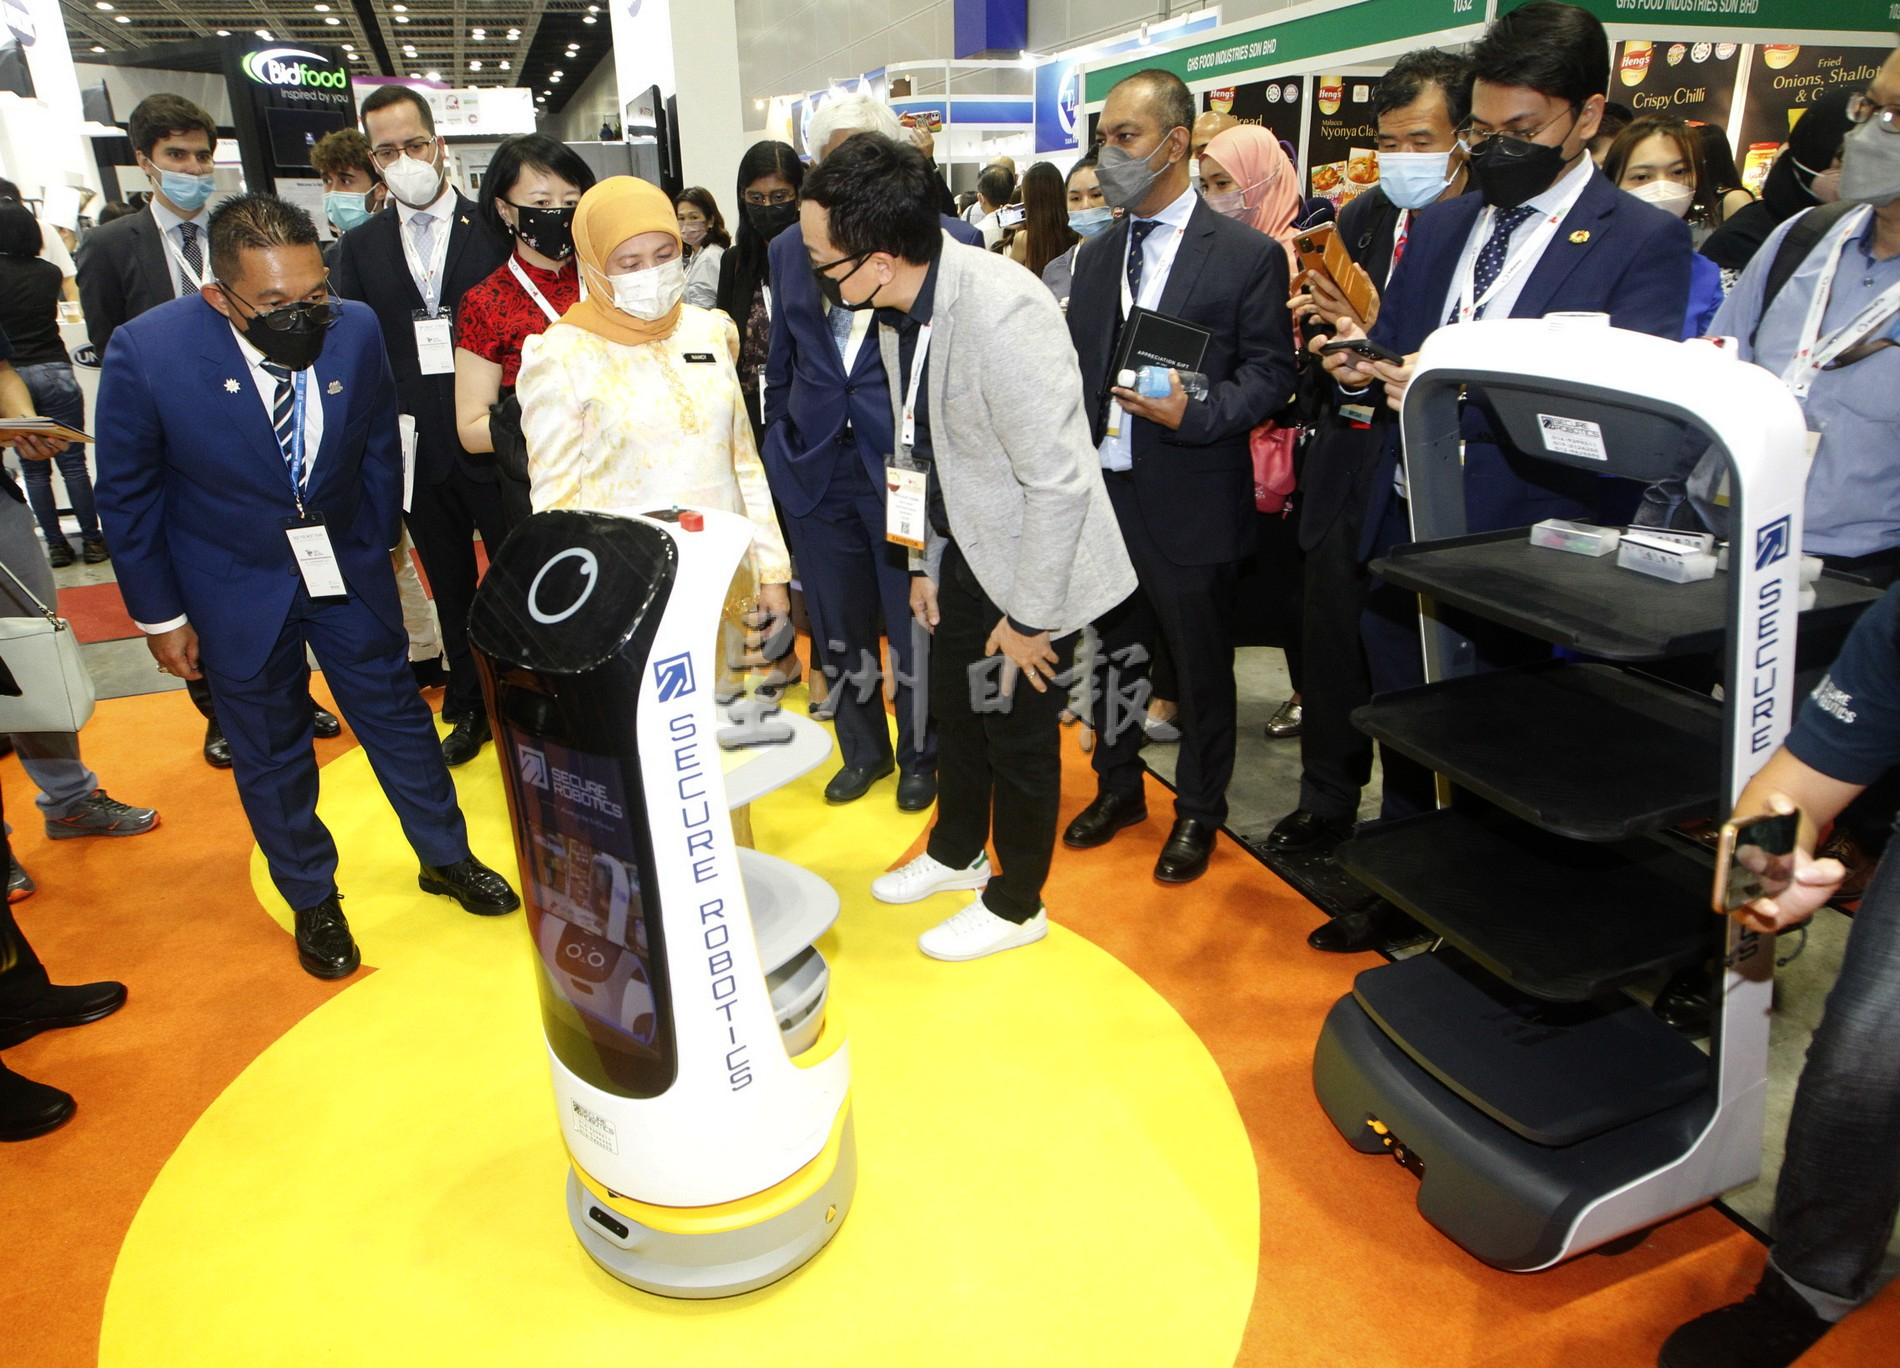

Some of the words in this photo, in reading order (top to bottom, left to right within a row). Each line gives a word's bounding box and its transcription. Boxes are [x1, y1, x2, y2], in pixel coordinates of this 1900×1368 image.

[1665, 0, 1718, 12] INDUSTRIES
[1719, 0, 1738, 13] SDN
[1738, 0, 1759, 14] BHD
[1186, 56, 1199, 72] GHS
[1198, 52, 1215, 69] FOOD
[1214, 44, 1249, 66] INDUSTRIES
[1248, 41, 1263, 58] SDN
[1262, 38, 1277, 55] BHD
[1817, 56, 1843, 68] Fried
[267, 60, 347, 88] Bidfood
[1773, 74, 1825, 89] Onions,
[317, 90, 330, 103] by
[330, 93, 349, 104] you
[1632, 92, 1673, 109] Crispy
[1673, 87, 1706, 105] Chilli
[1320, 126, 1357, 140] Nyonya
[1137, 350, 1176, 366] APPRECIATION
[1176, 361, 1190, 370] GIFT
[1751, 578, 1782, 754] SECURE
[551, 767, 607, 799] SECURE
[553, 781, 623, 819] ROBOTICS
[669, 713, 718, 884] SECURE
[699, 898, 752, 1091] ROBOTICS
